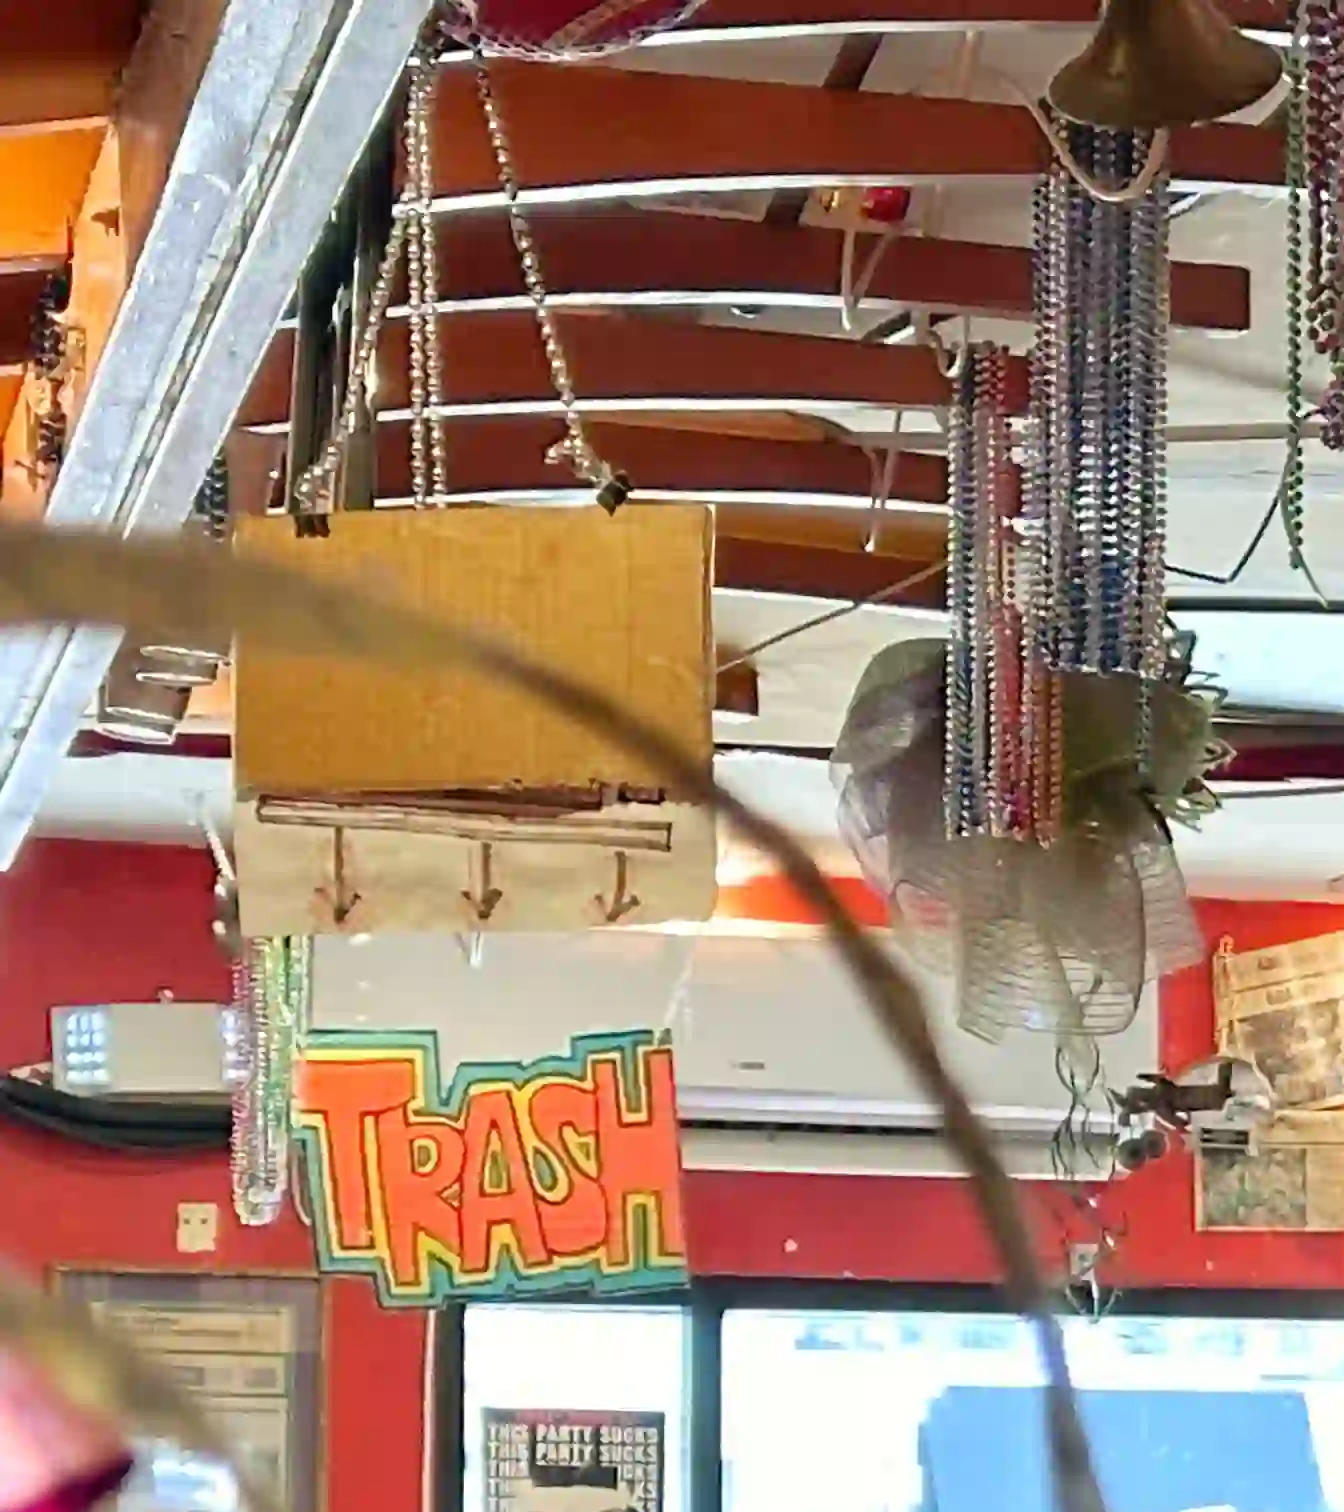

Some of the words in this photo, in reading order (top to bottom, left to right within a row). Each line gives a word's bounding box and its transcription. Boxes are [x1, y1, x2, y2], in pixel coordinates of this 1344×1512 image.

[304, 1050, 684, 1286] TRASH
[535, 1424, 593, 1442] PARTY
[600, 1426, 658, 1443] SUCKS
[488, 1442, 529, 1460] THIS
[535, 1443, 593, 1463] PARTY
[600, 1445, 657, 1462] SUCKS
